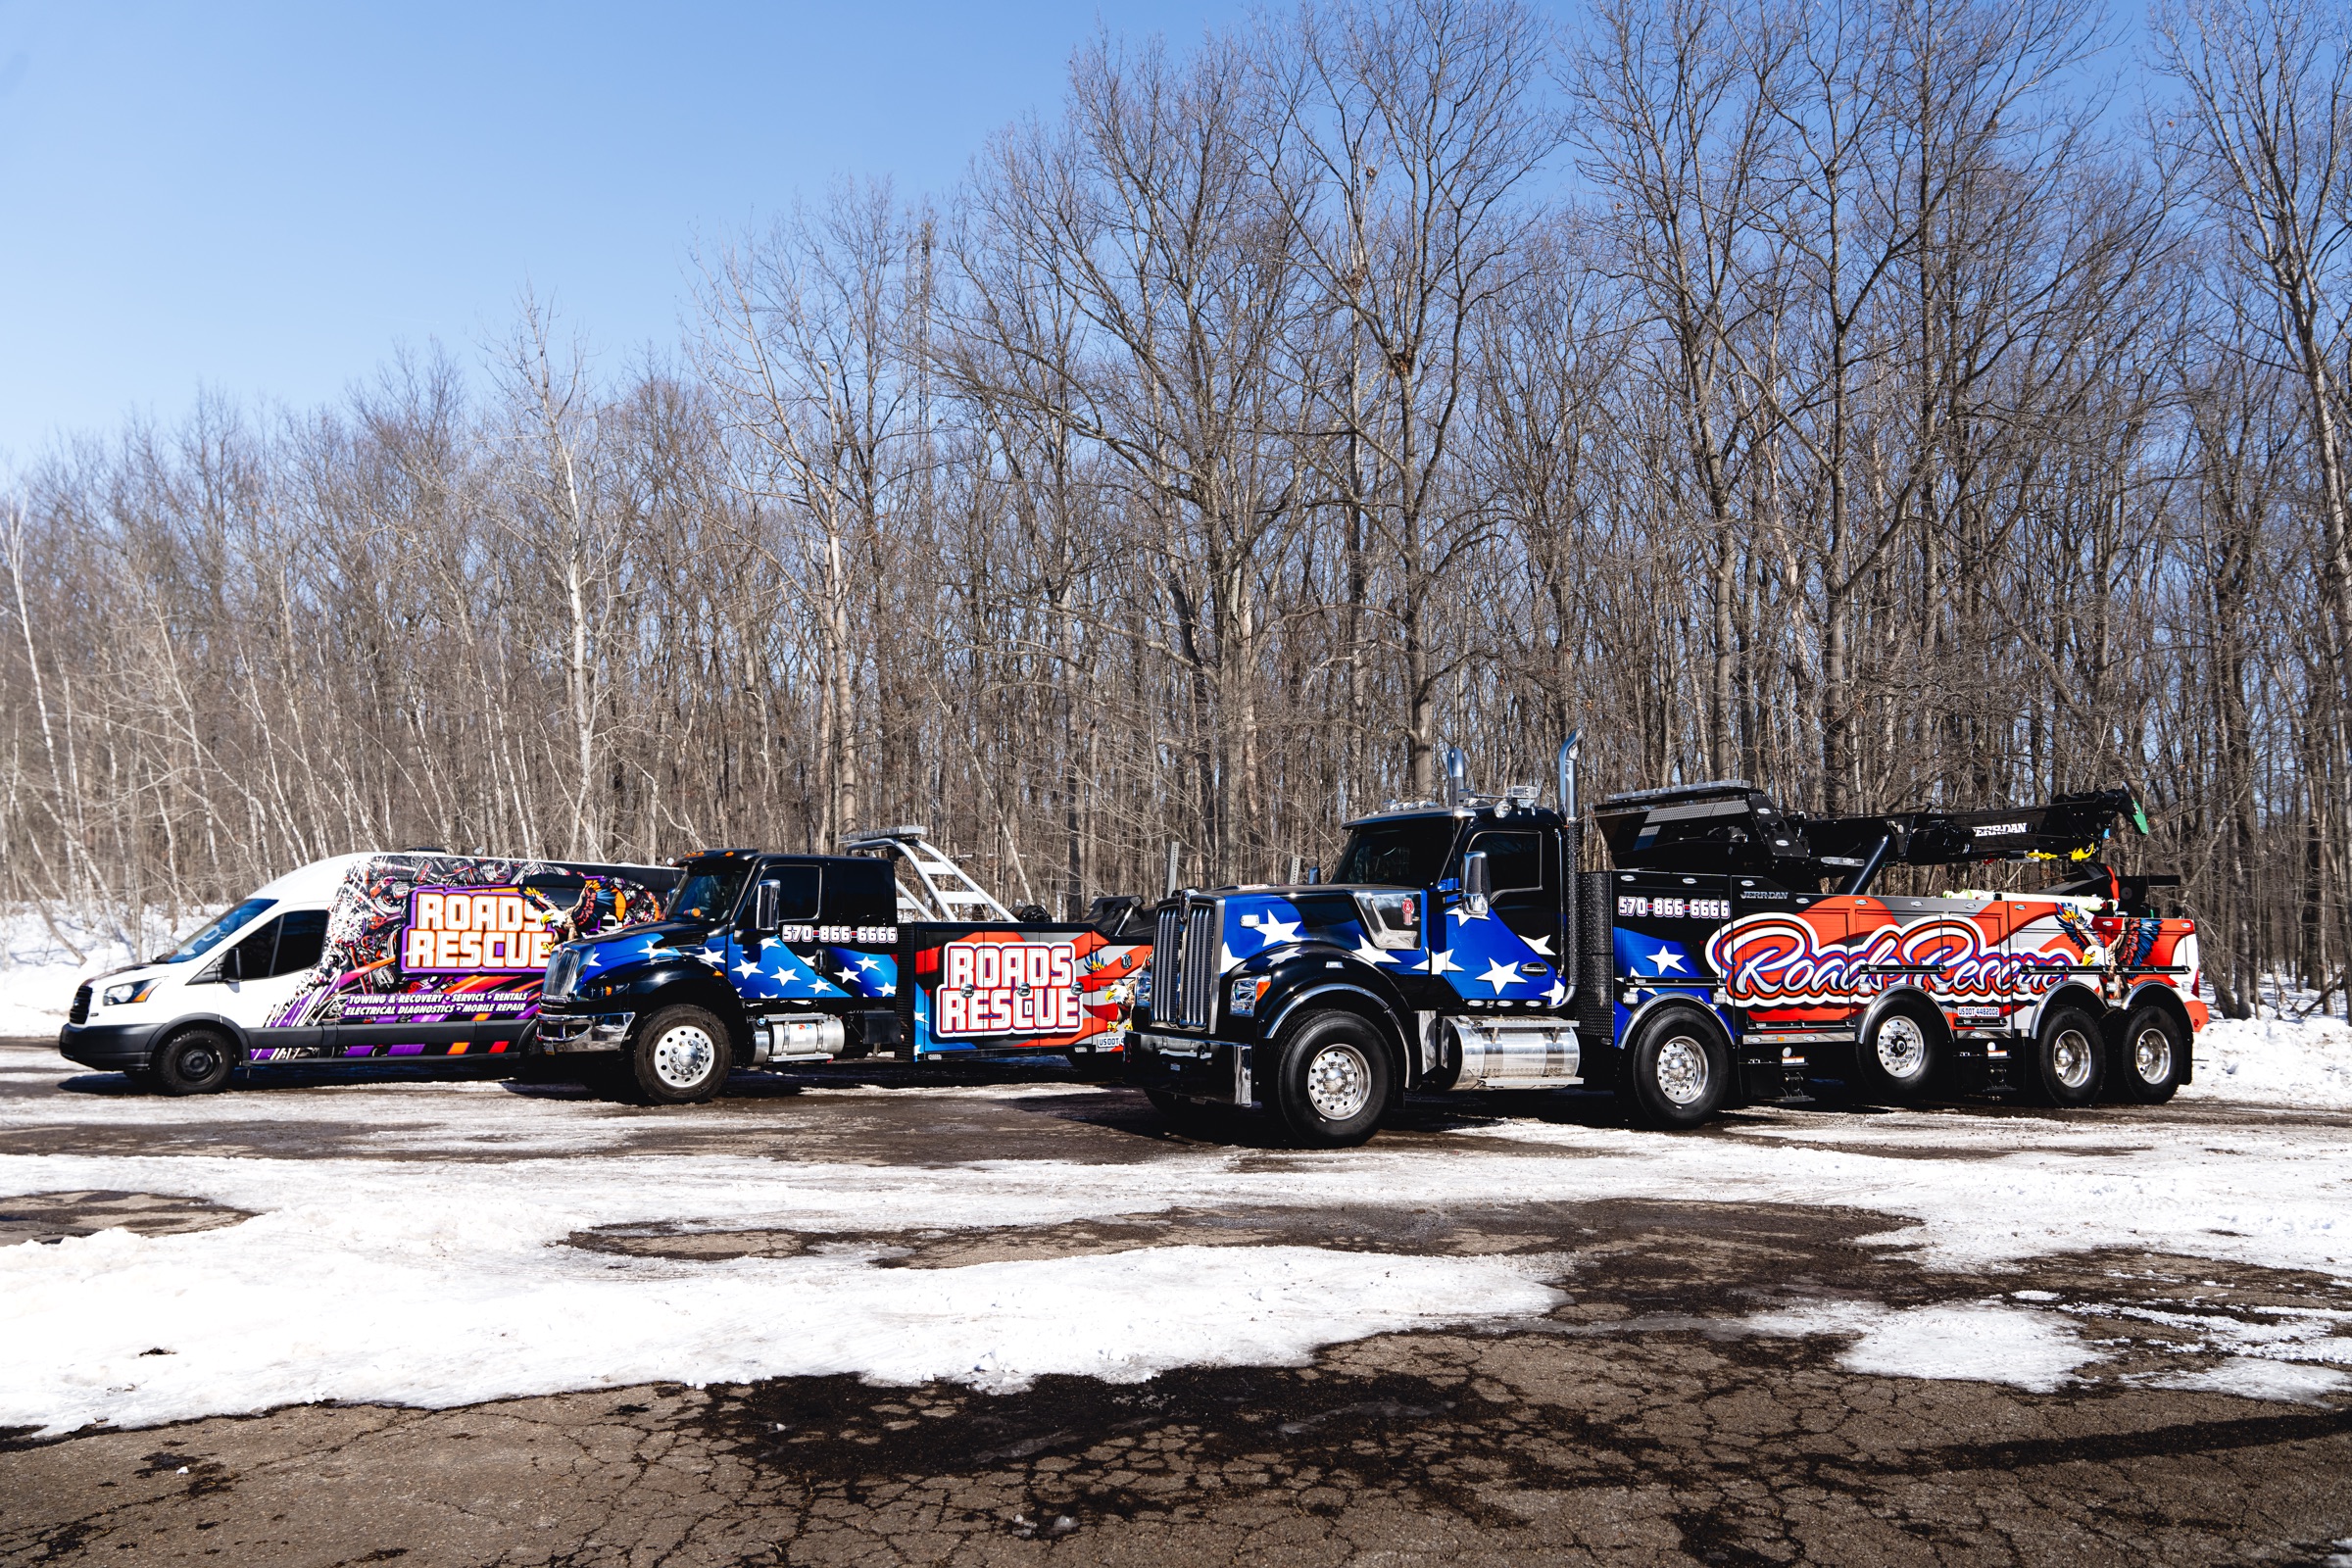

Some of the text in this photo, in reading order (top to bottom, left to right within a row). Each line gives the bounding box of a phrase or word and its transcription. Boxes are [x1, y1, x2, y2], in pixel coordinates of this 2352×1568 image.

[416, 892, 546, 932] ROADS
[1618, 896, 1731, 919] 570-866-6666
[782, 924, 899, 943] 570-866-6666
[407, 930, 554, 968] RESCUE
[947, 945, 1074, 989] ROADS
[345, 1003, 526, 1015] ELECTRICAL DIAGNOSTICS MOBILE REPAIR
[348, 992, 528, 1004] TOWING & RECOVERY SERVICE RENTALS
[939, 987, 1082, 1033] RESCUE
